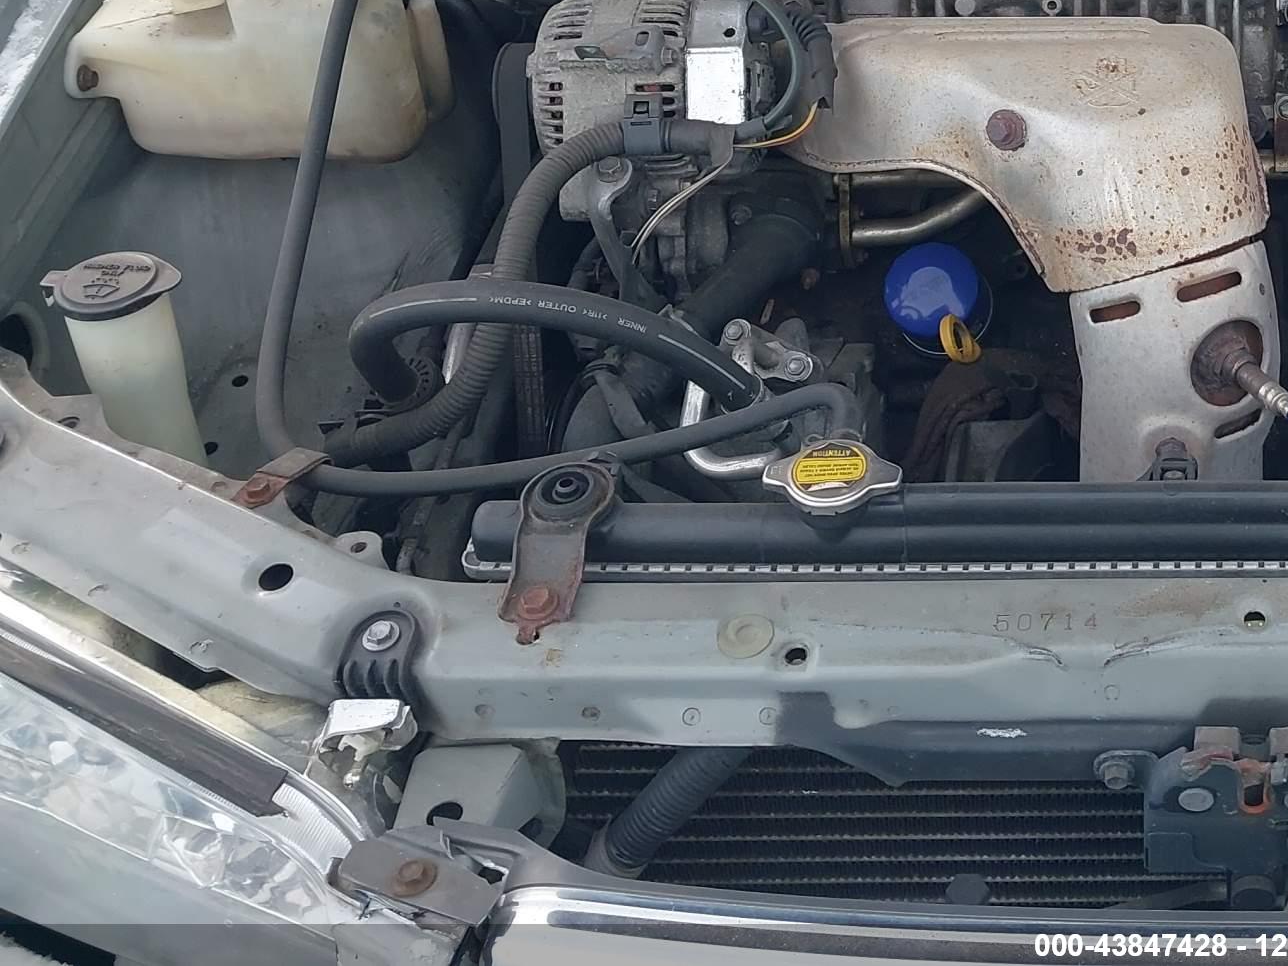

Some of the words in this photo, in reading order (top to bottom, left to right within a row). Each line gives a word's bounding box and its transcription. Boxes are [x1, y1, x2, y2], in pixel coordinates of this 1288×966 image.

[537, 300, 577, 314] OUTER
[617, 316, 647, 334] INNER
[812, 449, 852, 458] ATTENTION
[992, 613, 1097, 632] 50714
